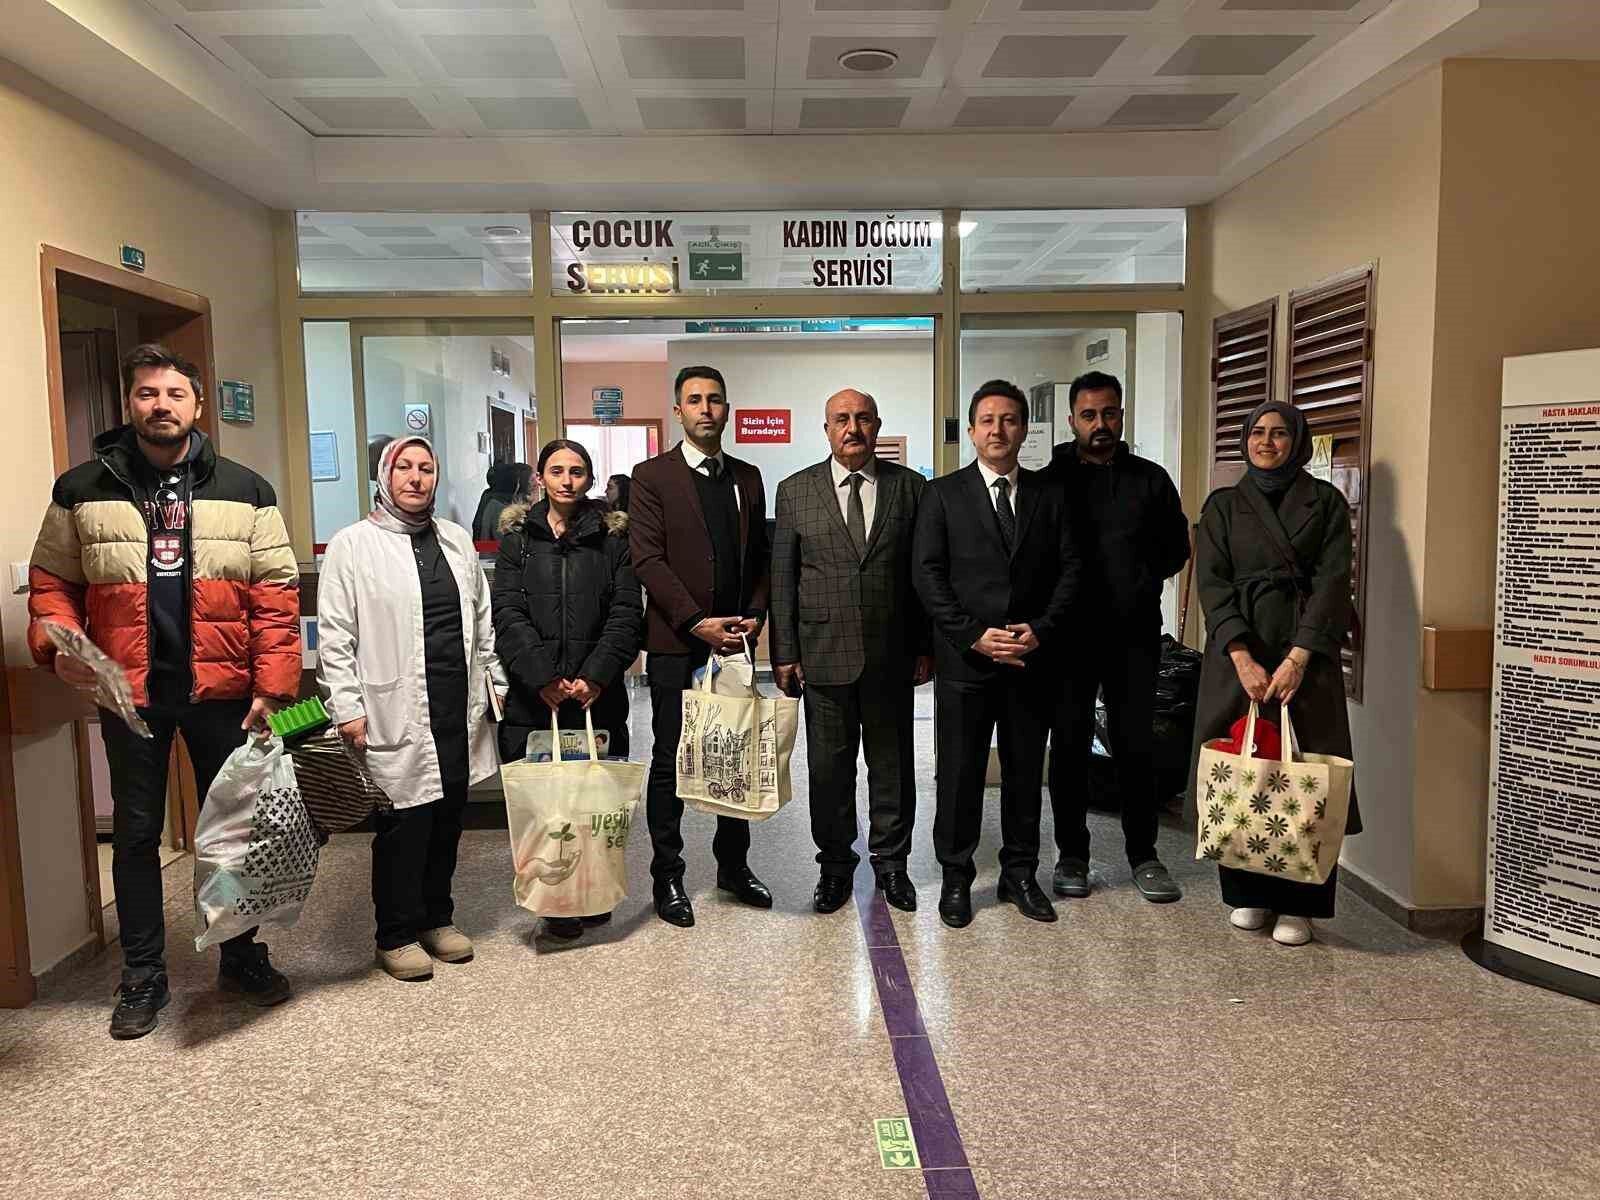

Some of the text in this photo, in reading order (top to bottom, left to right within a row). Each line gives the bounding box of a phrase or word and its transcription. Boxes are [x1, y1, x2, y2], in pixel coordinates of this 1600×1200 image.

[572, 220, 674, 251] ÇOCUK
[783, 214, 932, 248] KADIN DOĞUM
[567, 256, 680, 292] SERVİSİ
[813, 253, 893, 287] SERVİSİ
[742, 415, 784, 427] Sizin İçin
[1542, 408, 1566, 417] HASTA
[741, 427, 786, 436] Buradayız
[1534, 654, 1557, 664] HASTA
